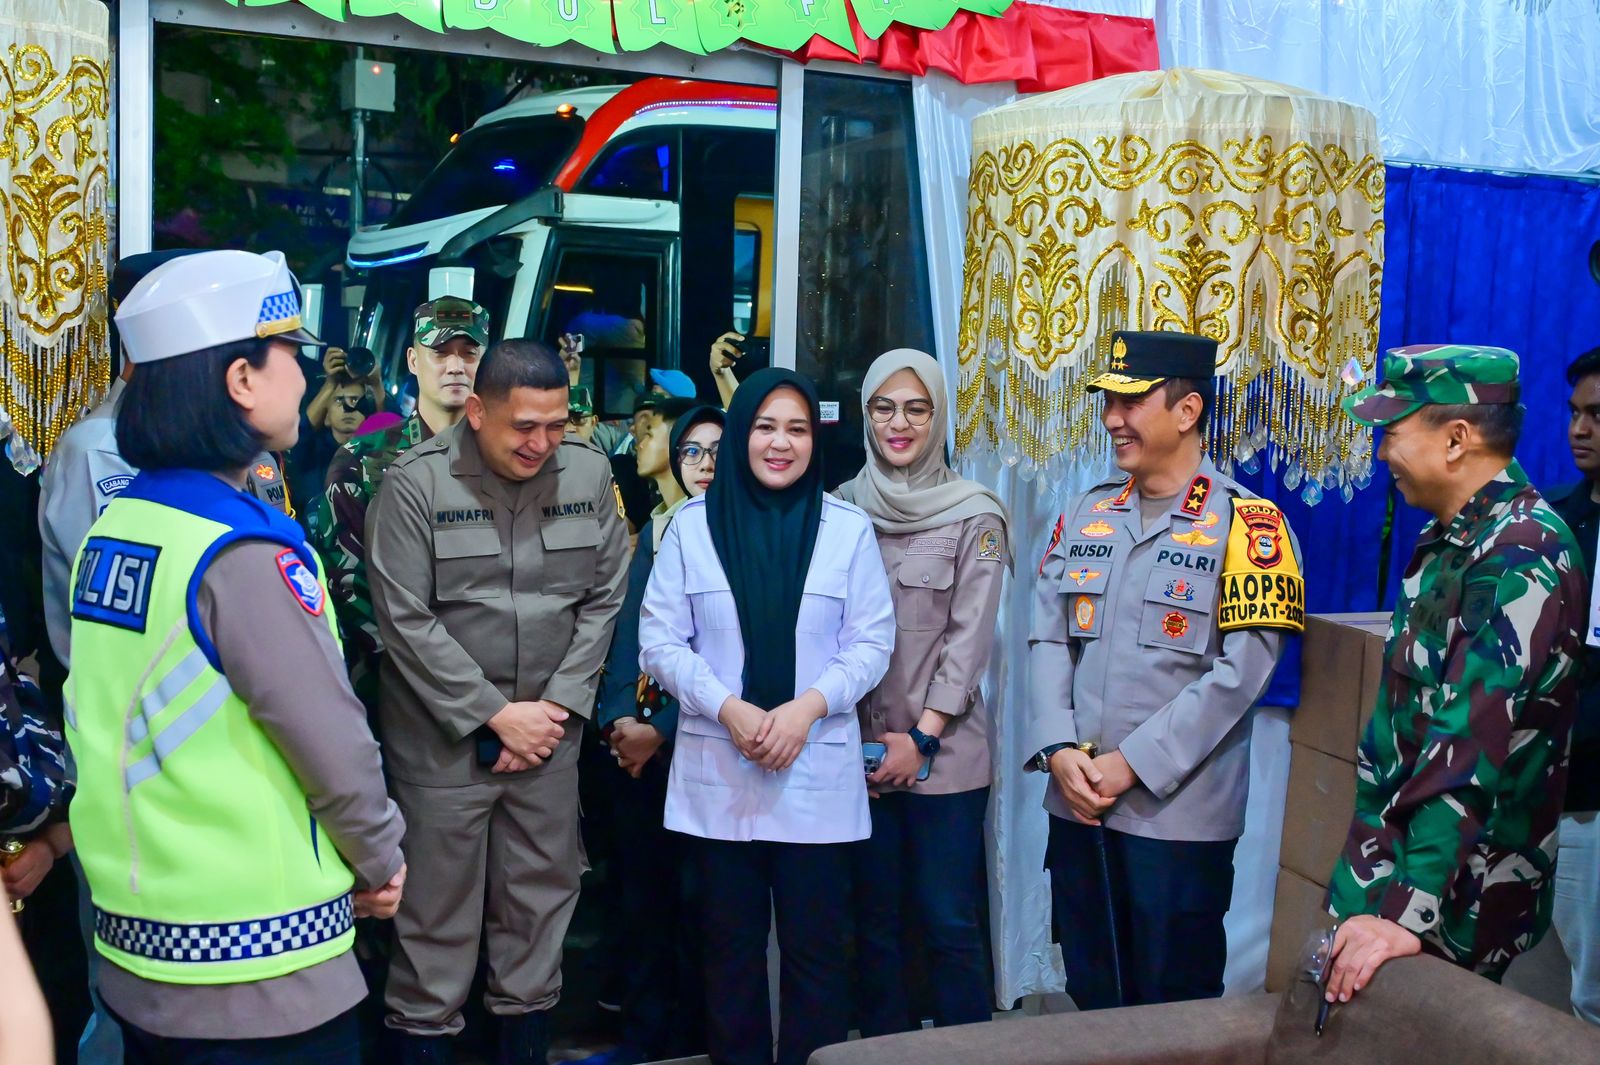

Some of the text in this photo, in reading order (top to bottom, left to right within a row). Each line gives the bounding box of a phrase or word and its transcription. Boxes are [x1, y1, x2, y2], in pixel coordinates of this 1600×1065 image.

[436, 509, 494, 524] MUNAFRI
[541, 501, 595, 518] WALIKOTA
[1241, 506, 1278, 518] POLDA
[1069, 544, 1113, 559] RUSDI
[1156, 550, 1216, 573] POLRI
